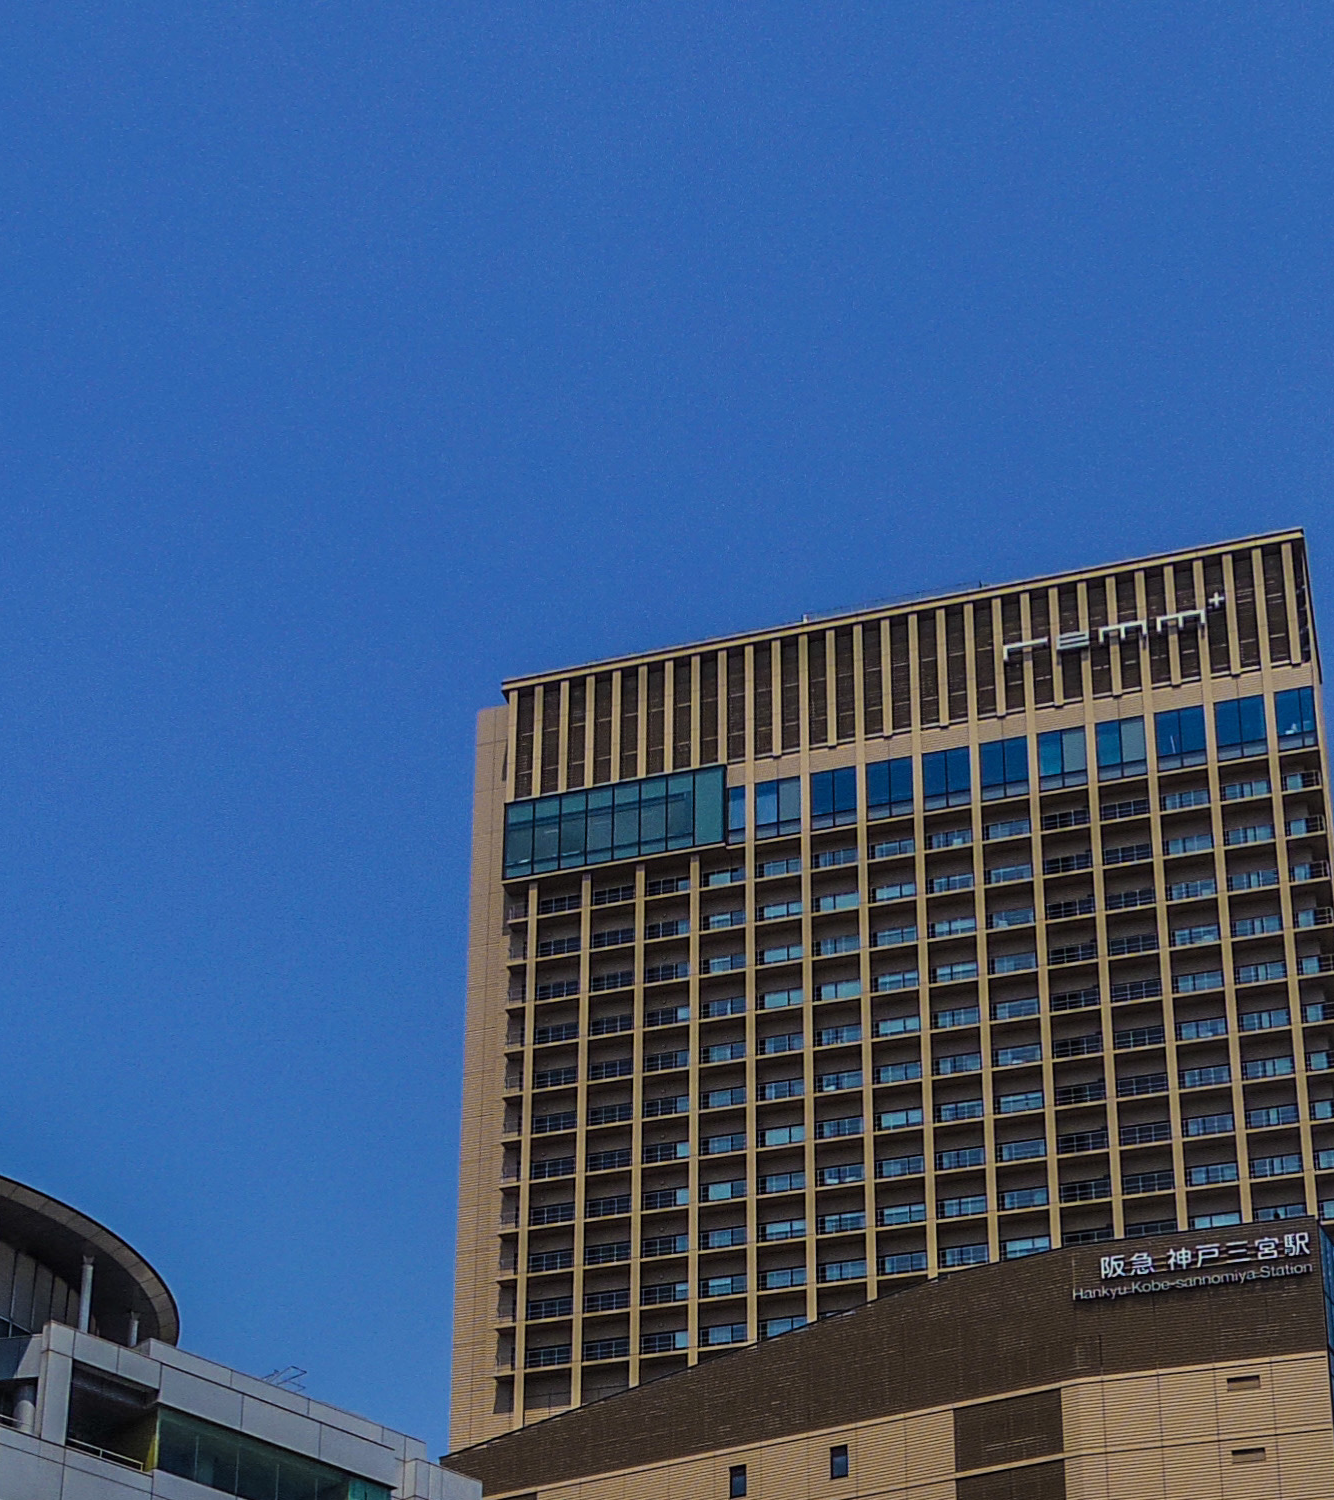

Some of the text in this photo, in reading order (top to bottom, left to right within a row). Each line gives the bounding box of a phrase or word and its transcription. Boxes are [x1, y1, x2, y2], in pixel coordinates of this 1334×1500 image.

[1101, 1232, 1310, 1279] 阪急 神戸三宮駅
[1072, 1284, 1127, 1301] Hankyu
[1259, 1262, 1313, 1279] Station
